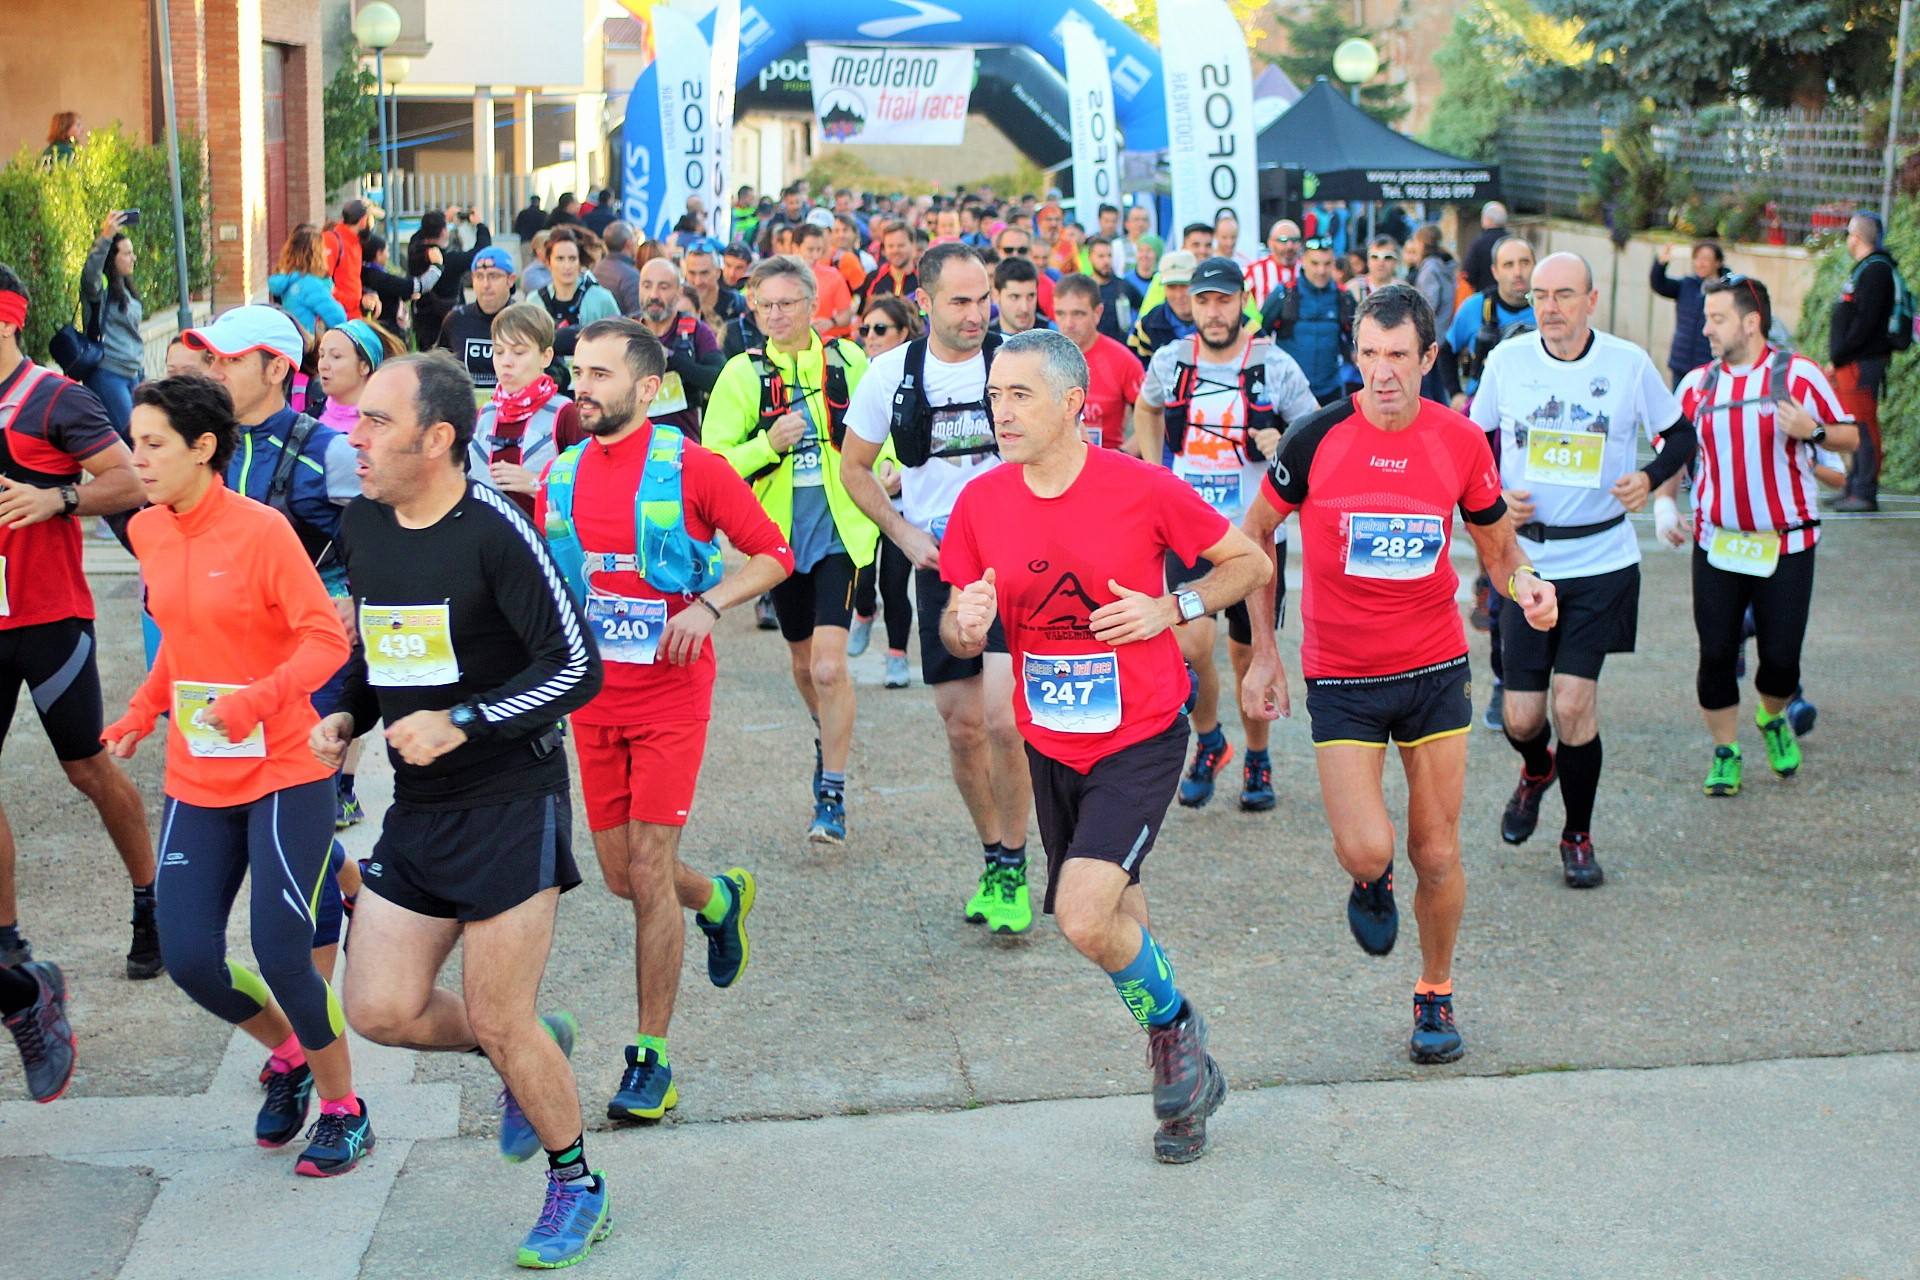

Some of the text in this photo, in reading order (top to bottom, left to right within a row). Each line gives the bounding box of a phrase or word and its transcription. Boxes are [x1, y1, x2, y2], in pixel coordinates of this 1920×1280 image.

[830, 47, 939, 88] medrano
[876, 88, 965, 121] trail race
[793, 452, 821, 470] 29
[1369, 455, 1408, 469] land
[1543, 447, 1583, 468] 481
[1371, 536, 1424, 558] 282
[1726, 538, 1763, 558] 473
[602, 619, 649, 640] 240
[378, 633, 427, 659] 439
[1041, 681, 1094, 705] 247
